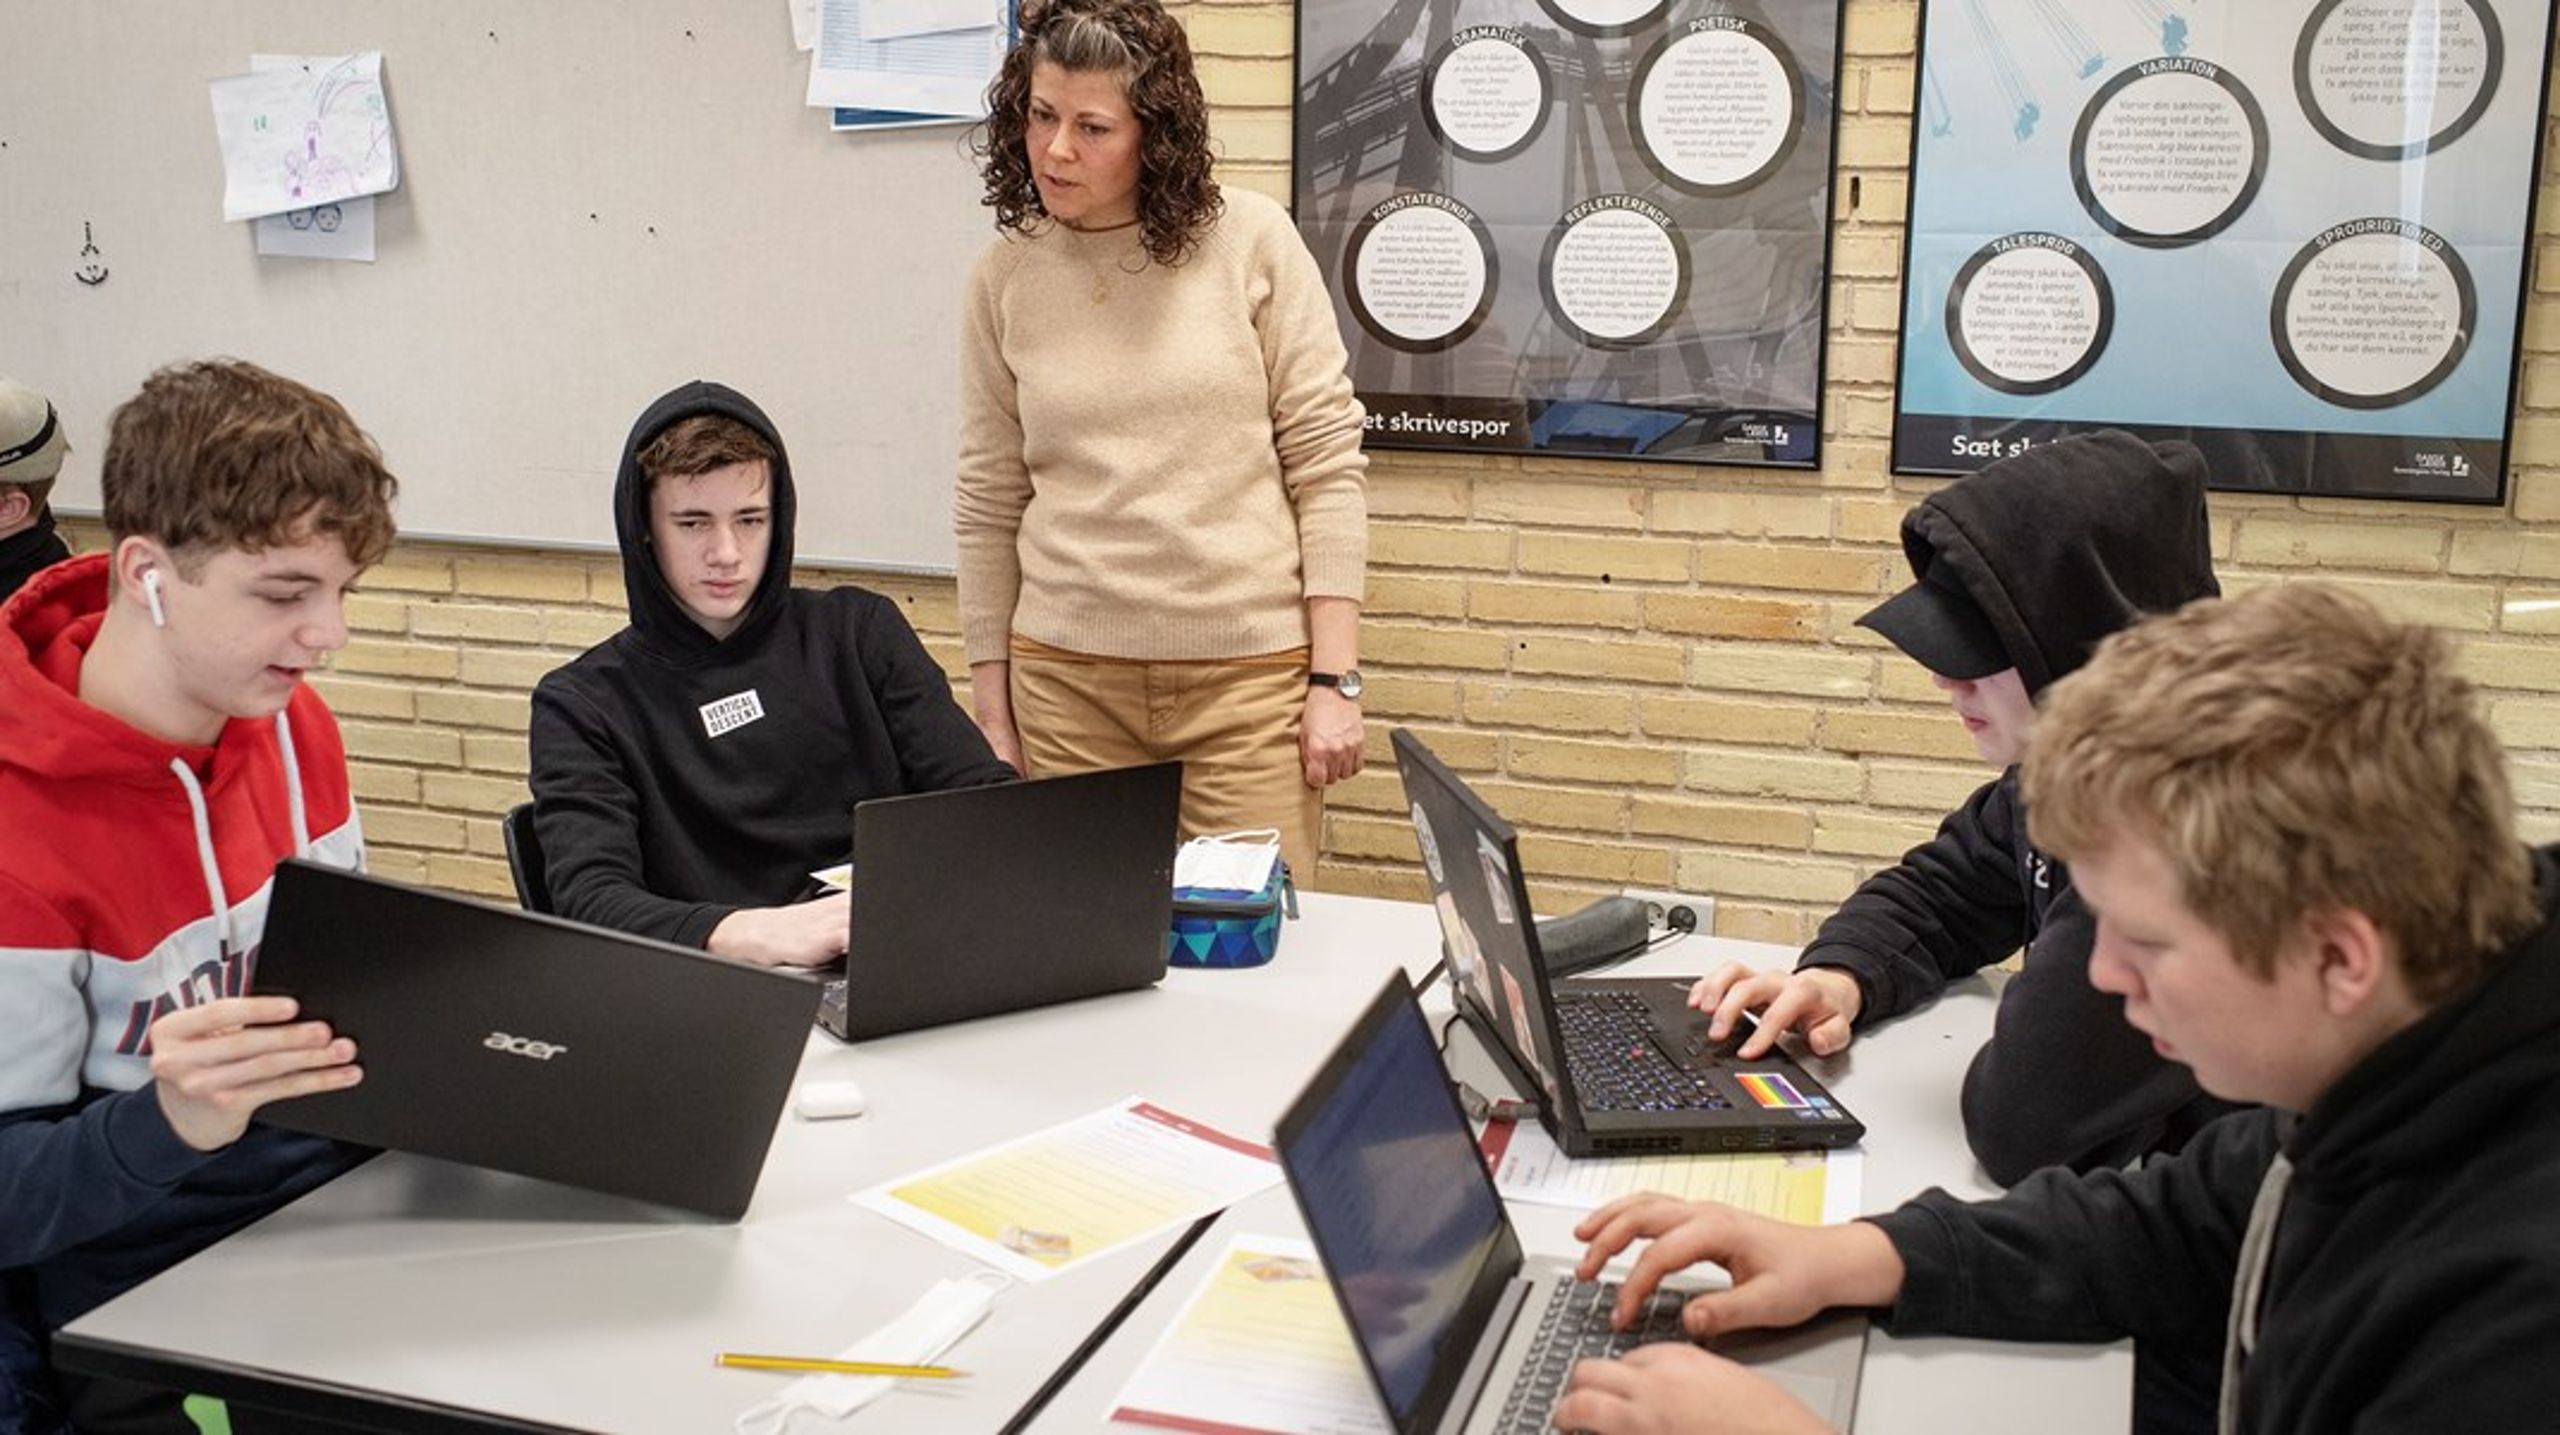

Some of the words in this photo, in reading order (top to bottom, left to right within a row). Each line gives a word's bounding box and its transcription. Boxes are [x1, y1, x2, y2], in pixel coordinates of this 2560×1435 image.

[1452, 27, 1528, 48] DRAMATISK
[1688, 17, 1748, 32] POETISK
[2139, 58, 2218, 79] VARIATION
[1371, 193, 1475, 222] KONSTATERENDE
[1564, 195, 1673, 228] REFLEKTERENDE
[1992, 234, 2076, 255] TALESPROG
[1390, 410, 1511, 440] skrivespor
[1952, 434, 2002, 458] Sæt
[706, 695, 753, 721] VERTICAL
[710, 706, 757, 733] DESCENT
[483, 1032, 568, 1060] acer
